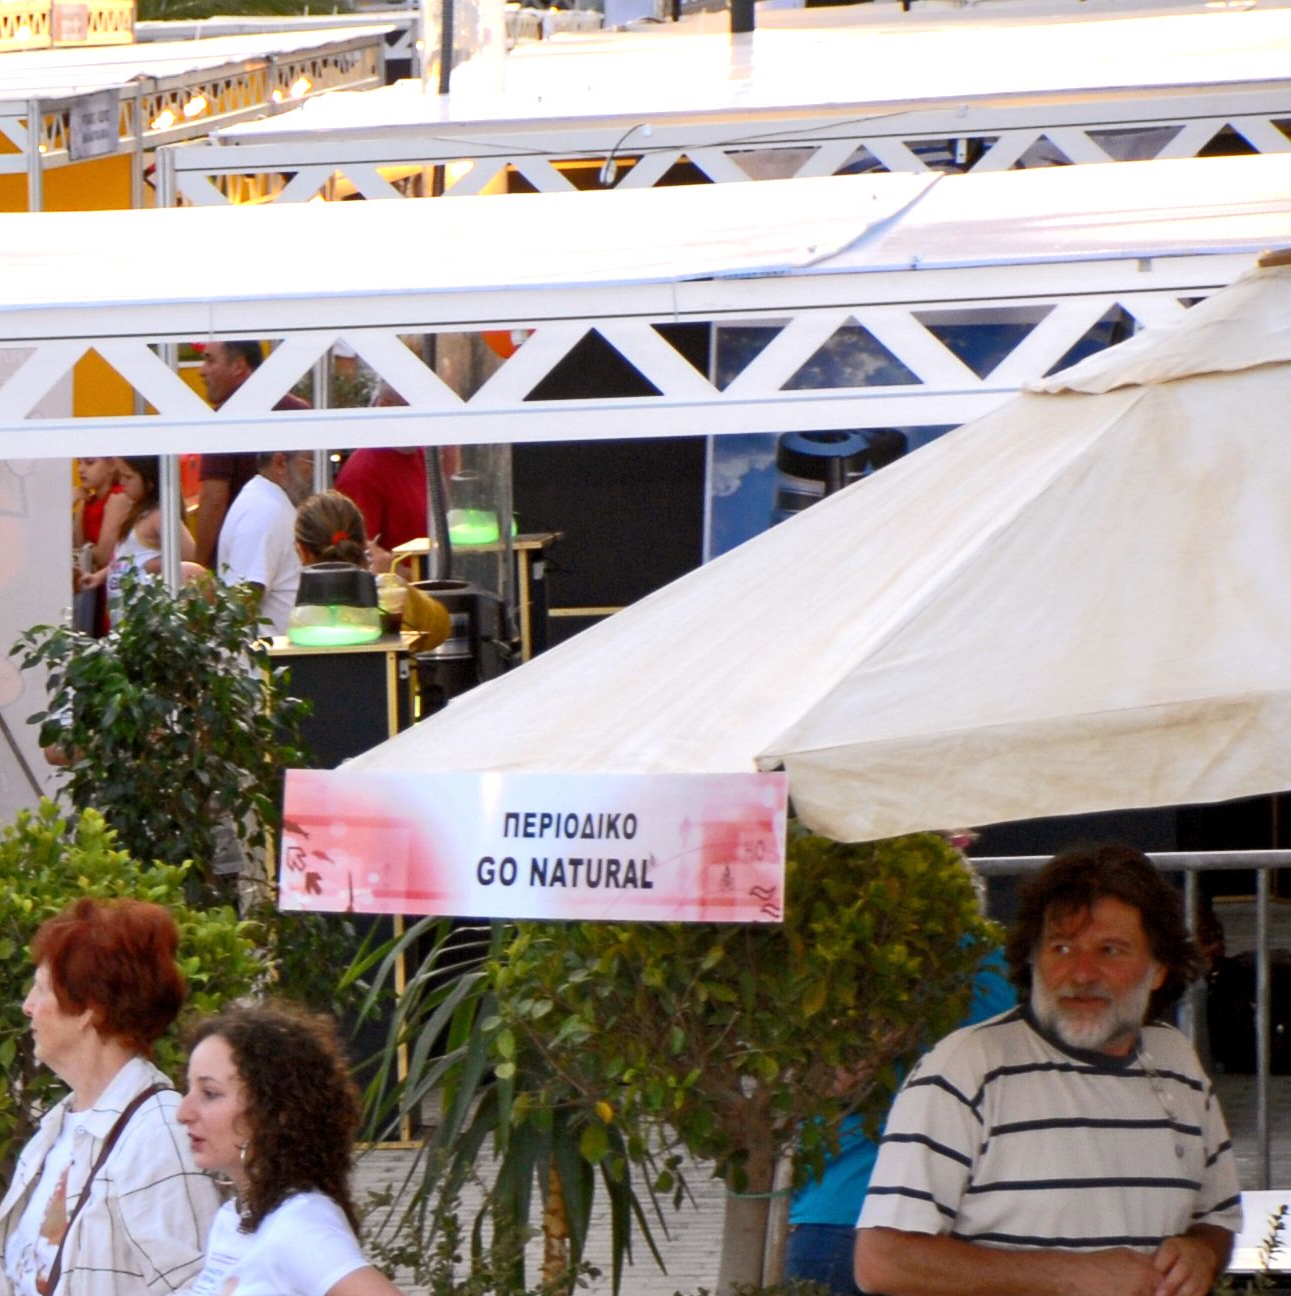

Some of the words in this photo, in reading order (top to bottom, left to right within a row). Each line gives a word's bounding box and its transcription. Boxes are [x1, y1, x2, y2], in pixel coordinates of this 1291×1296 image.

[503, 812, 638, 840] ΠΕΡΙΟΔΙΚΟ
[476, 856, 518, 887] GO
[530, 857, 654, 890] NATURAL
